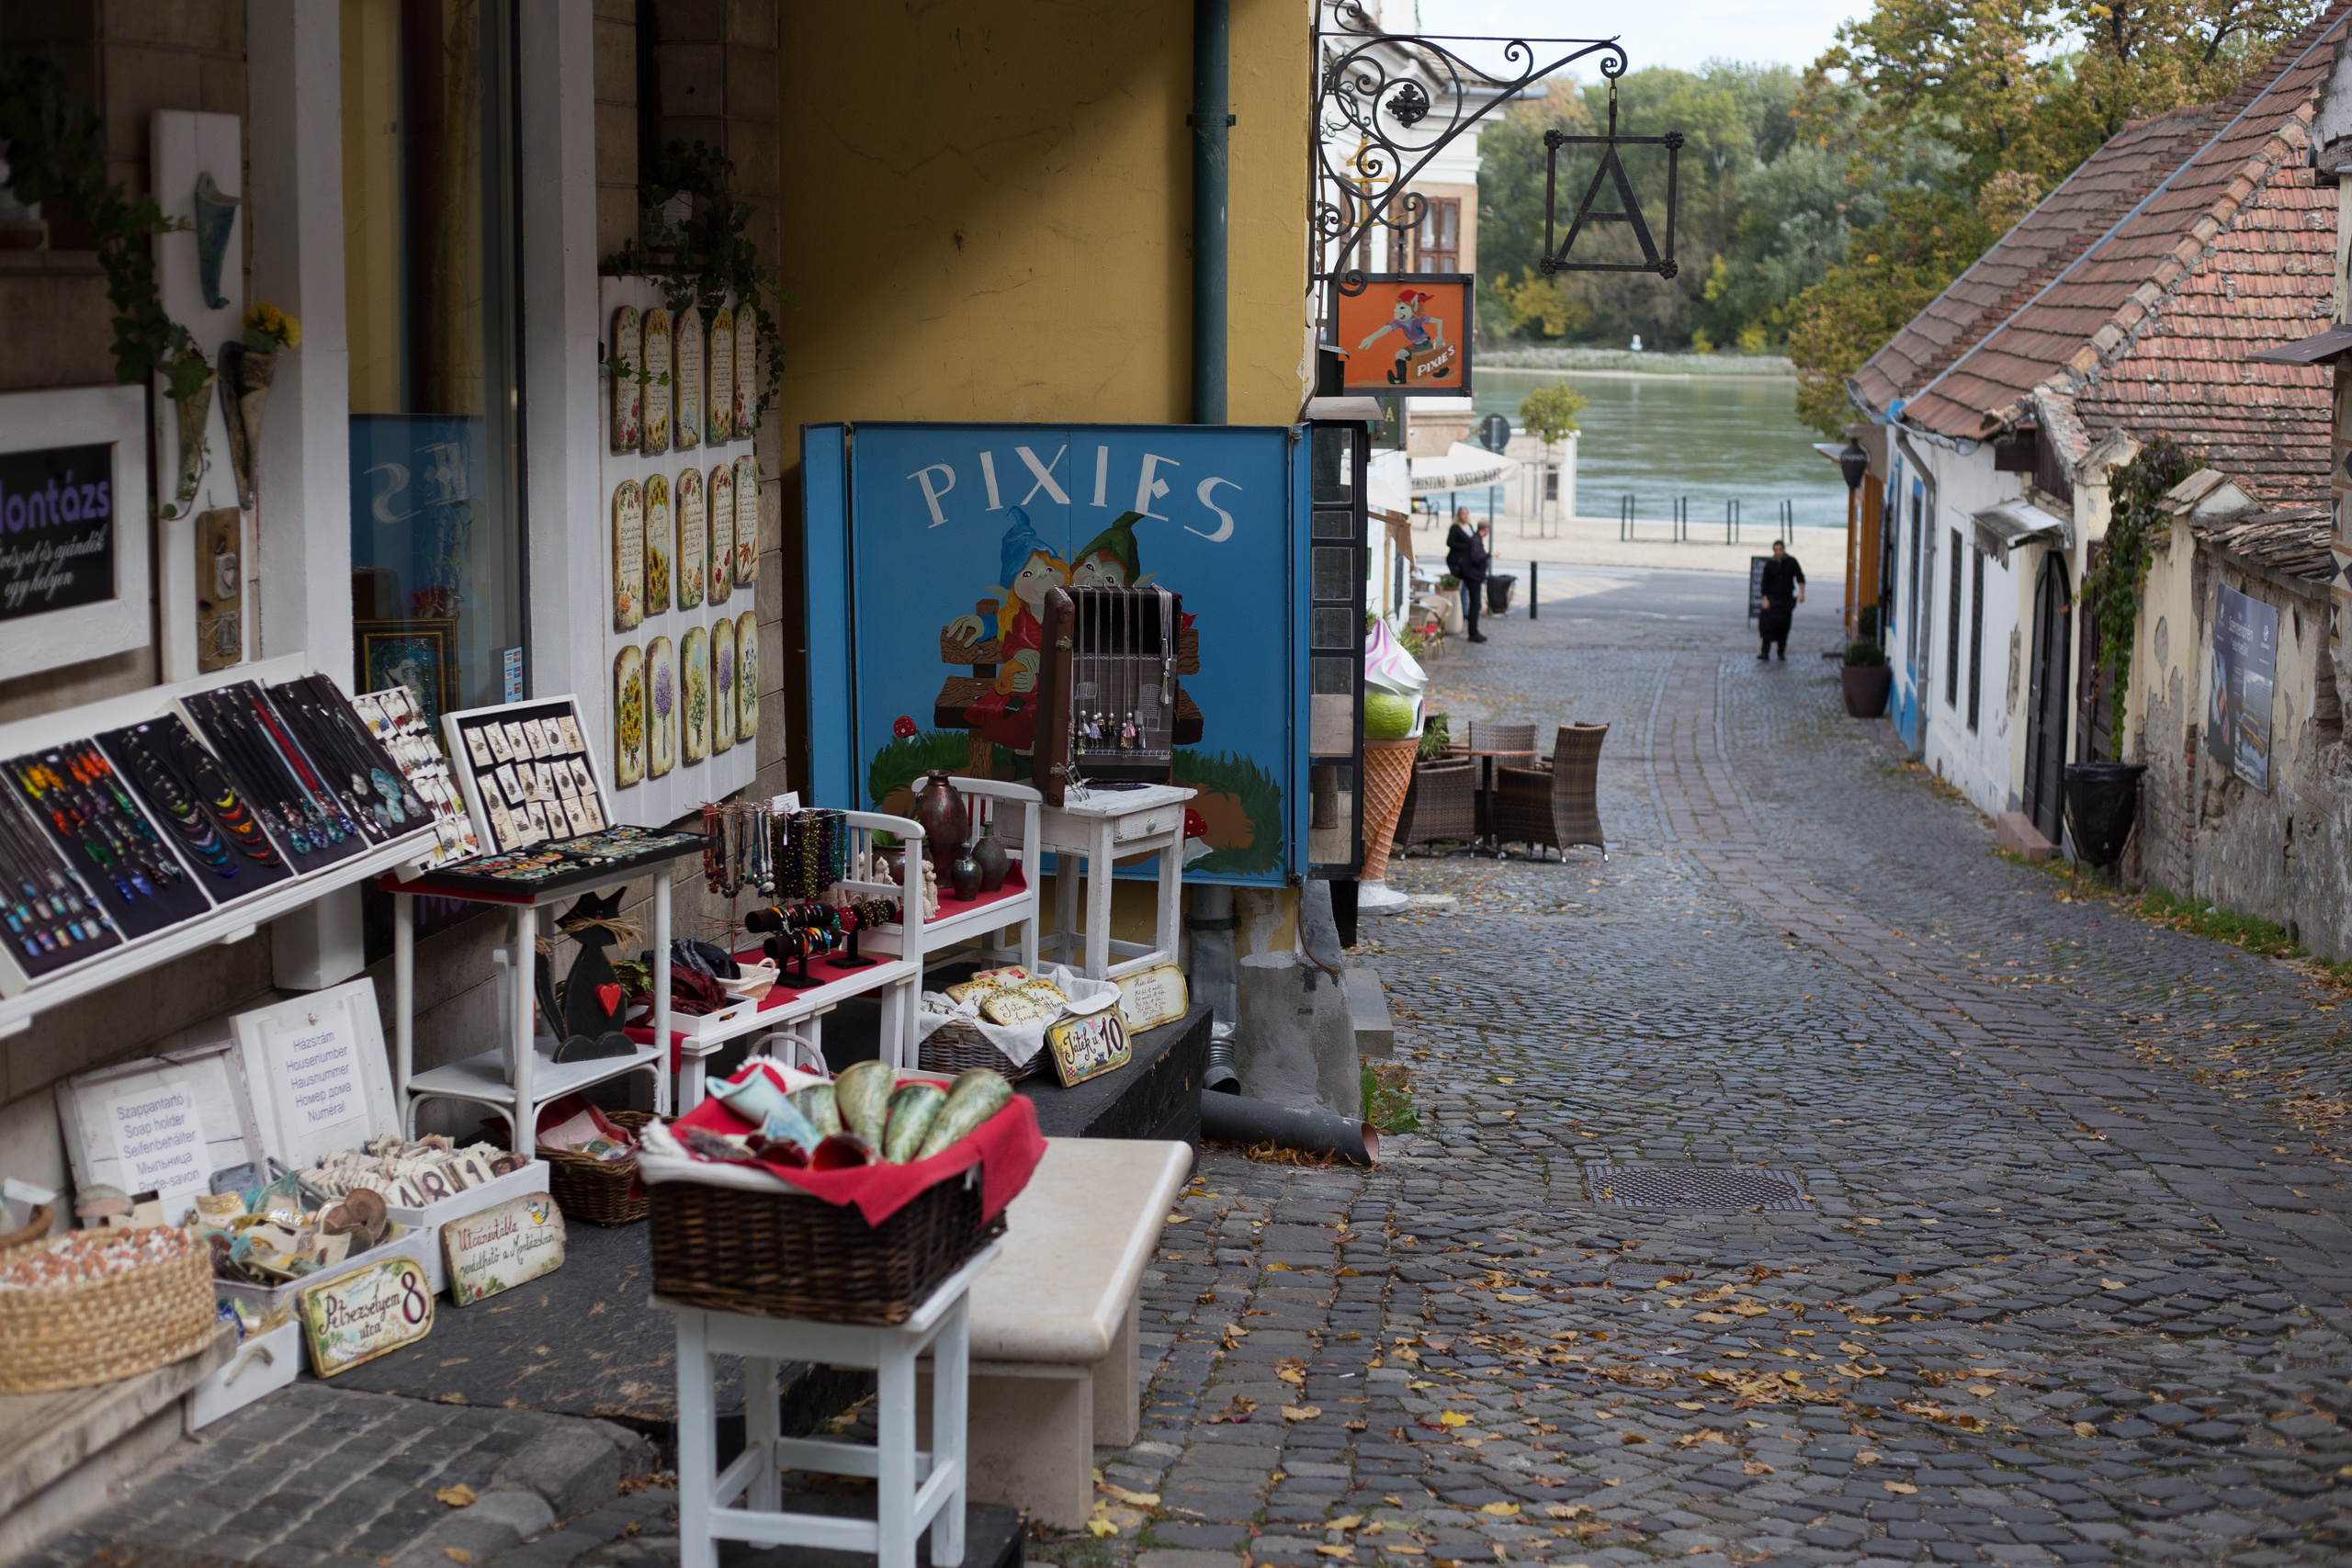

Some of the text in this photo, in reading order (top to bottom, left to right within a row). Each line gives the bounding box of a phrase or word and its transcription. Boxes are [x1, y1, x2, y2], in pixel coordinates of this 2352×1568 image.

[1417, 344, 1455, 378] PIXIES
[0, 469, 111, 534] ontázs
[907, 444, 1243, 543] PIXIES
[999, 1001, 1028, 1018] Isten
[292, 1032, 335, 1053] Házszám
[1063, 1026, 1096, 1066] Játék
[285, 1046, 348, 1074] Housenumber
[290, 1064, 350, 1090] Hausnummer
[116, 1092, 185, 1121] Szappantartó
[295, 1081, 352, 1109] Номер дома
[307, 1100, 345, 1123] Numéral
[124, 1113, 186, 1139] Soap holder
[122, 1131, 197, 1159] Seifenbehälter
[136, 1152, 193, 1176] Мыльница
[138, 1169, 200, 1193] Porte-savon
[458, 1213, 520, 1253] Utcanévtábla
[459, 1247, 500, 1280] rendelhető
[502, 1250, 509, 1260] a
[317, 1282, 401, 1337] Petrezselyem
[358, 1322, 382, 1340] utca
